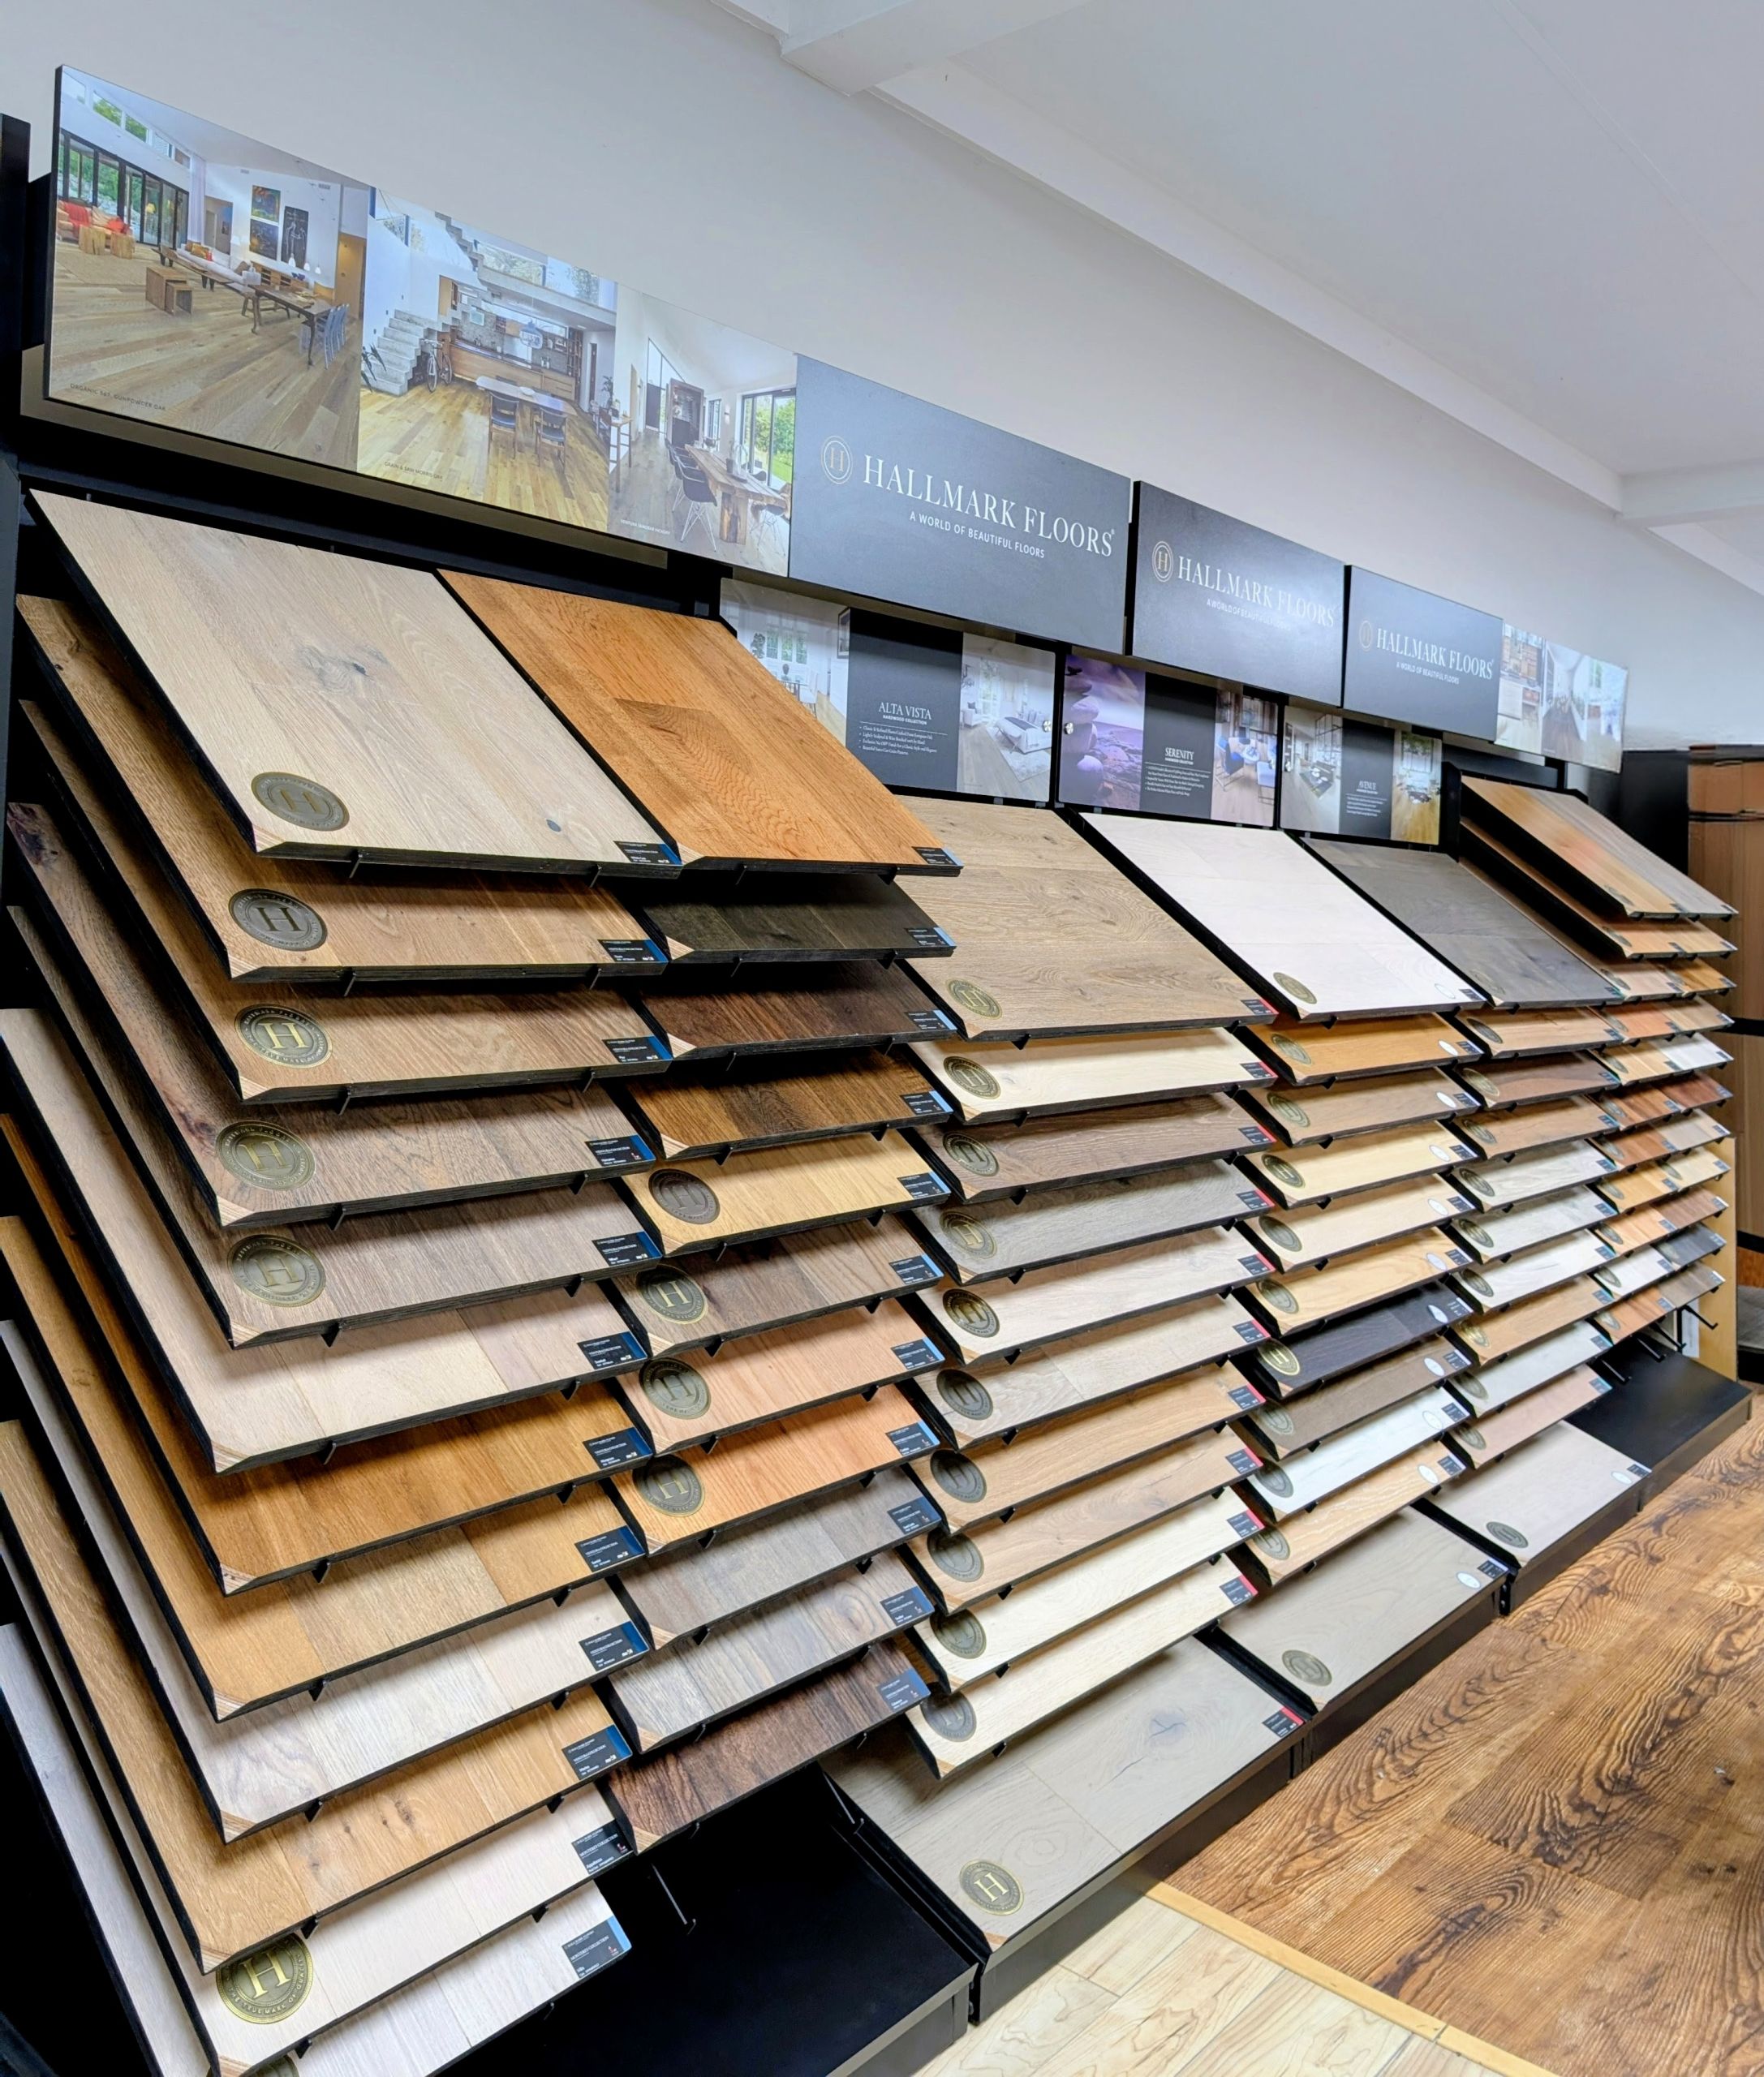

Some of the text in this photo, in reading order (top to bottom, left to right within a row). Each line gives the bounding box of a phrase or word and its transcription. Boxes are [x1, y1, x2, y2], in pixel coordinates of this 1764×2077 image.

[863, 454, 1016, 528] HALLMARK
[909, 511, 1045, 558] A WORLD OF BEAUTIFUL FLOORS
[1178, 556, 1272, 608] HALLMARK
[1211, 600, 1232, 613] WORLD
[1376, 628, 1446, 667] HALLMARK
[1400, 664, 1415, 673] WORLD
[1417, 666, 1422, 675] OF
[1423, 669, 1443, 681] BEAUTIFUL
[878, 701, 931, 720] ALTA VISTA
[1165, 746, 1194, 761] SERENITY
[258, 1023, 310, 1048] H
[652, 1280, 691, 1308] H
[974, 1872, 1009, 1902] H
[240, 1949, 292, 1999] H
